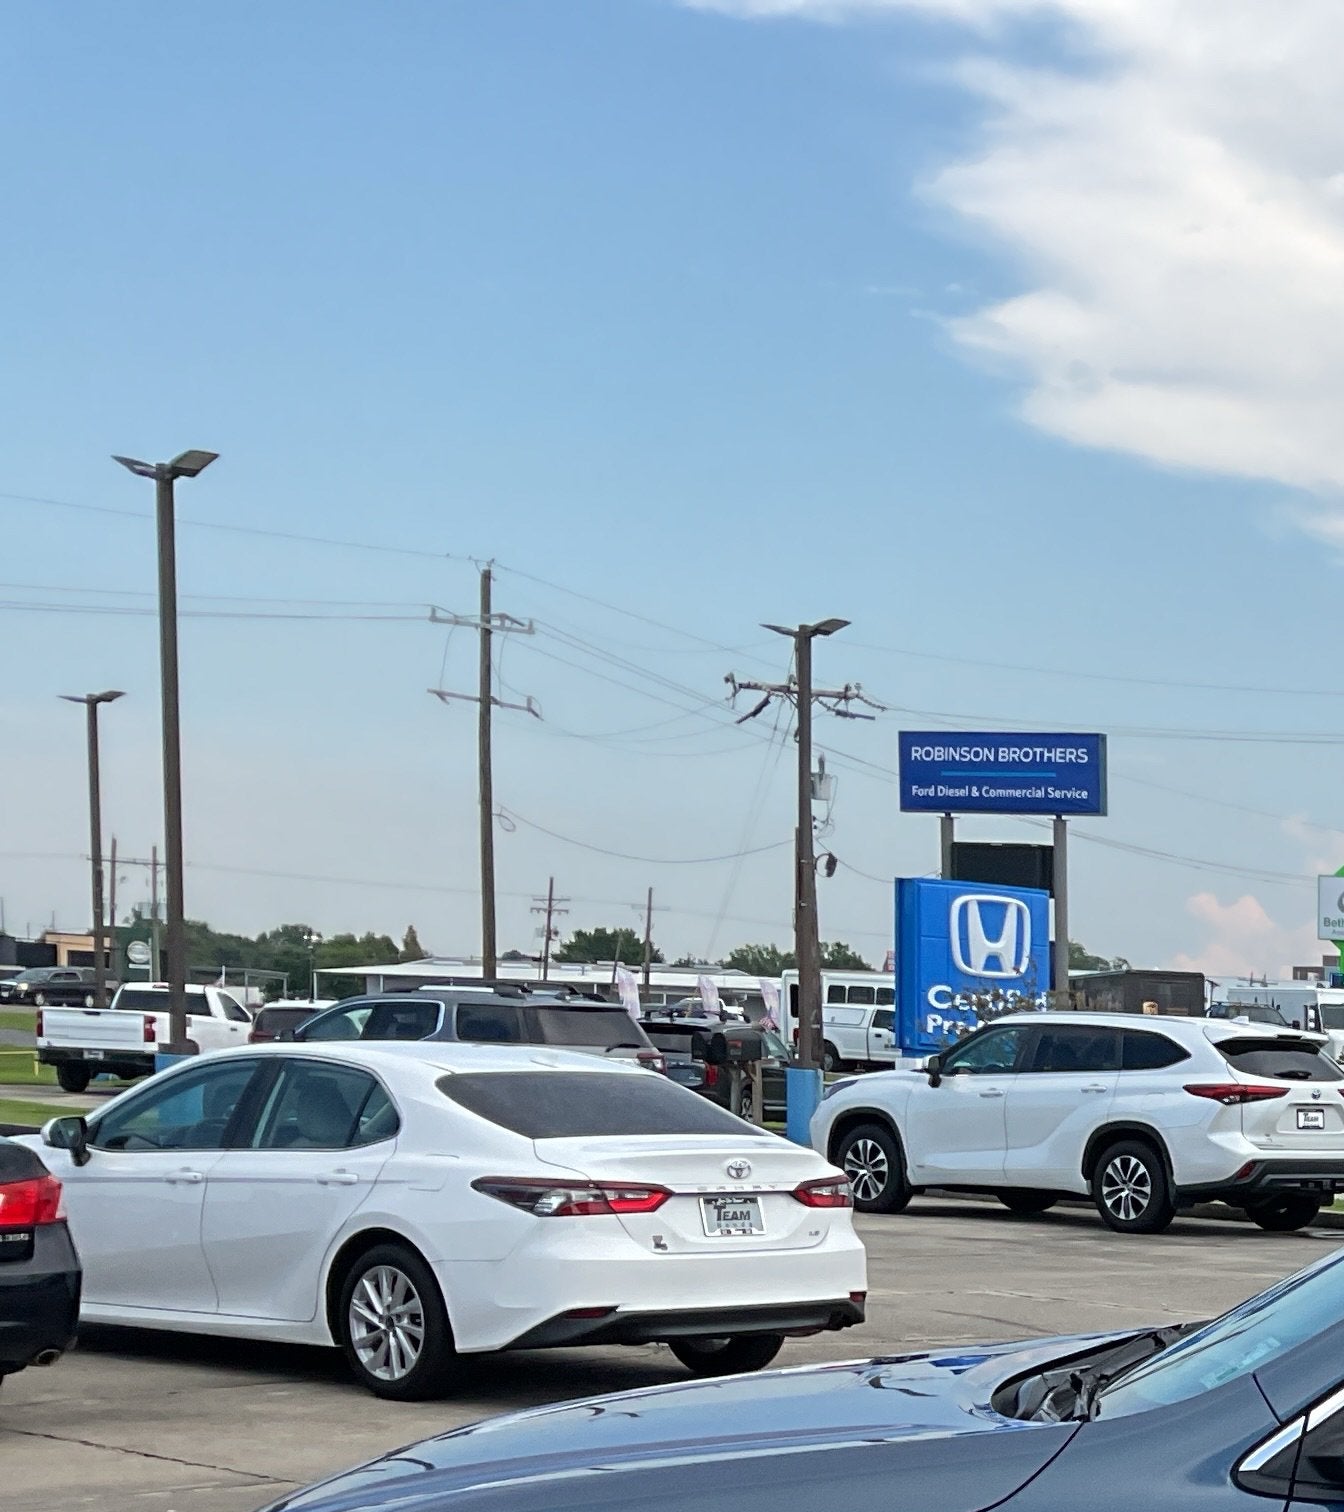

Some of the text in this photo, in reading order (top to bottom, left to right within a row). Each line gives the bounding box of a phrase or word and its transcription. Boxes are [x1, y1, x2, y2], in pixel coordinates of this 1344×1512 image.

[911, 746, 1089, 763] ROBINSON BROTHERS
[912, 785, 1089, 799] Ford Diesel & Commercial Service
